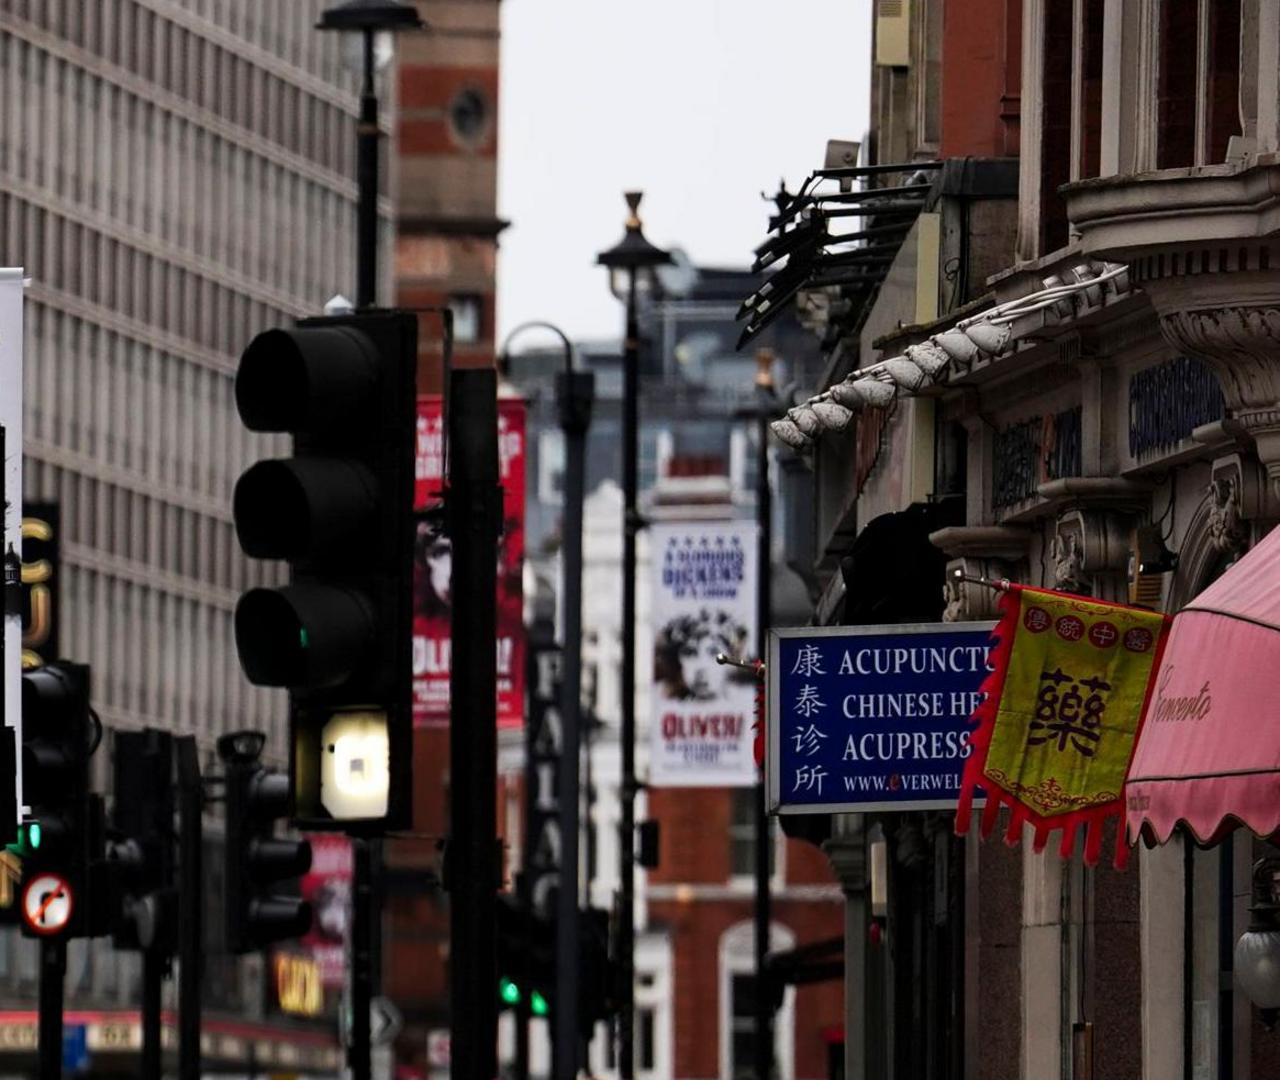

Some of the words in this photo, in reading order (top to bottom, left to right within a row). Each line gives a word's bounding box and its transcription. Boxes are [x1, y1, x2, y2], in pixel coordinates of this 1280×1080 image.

[790, 644, 829, 797] 康泰诊所
[842, 692, 943, 720] CHINESE
[1027, 667, 1112, 758] 藥
